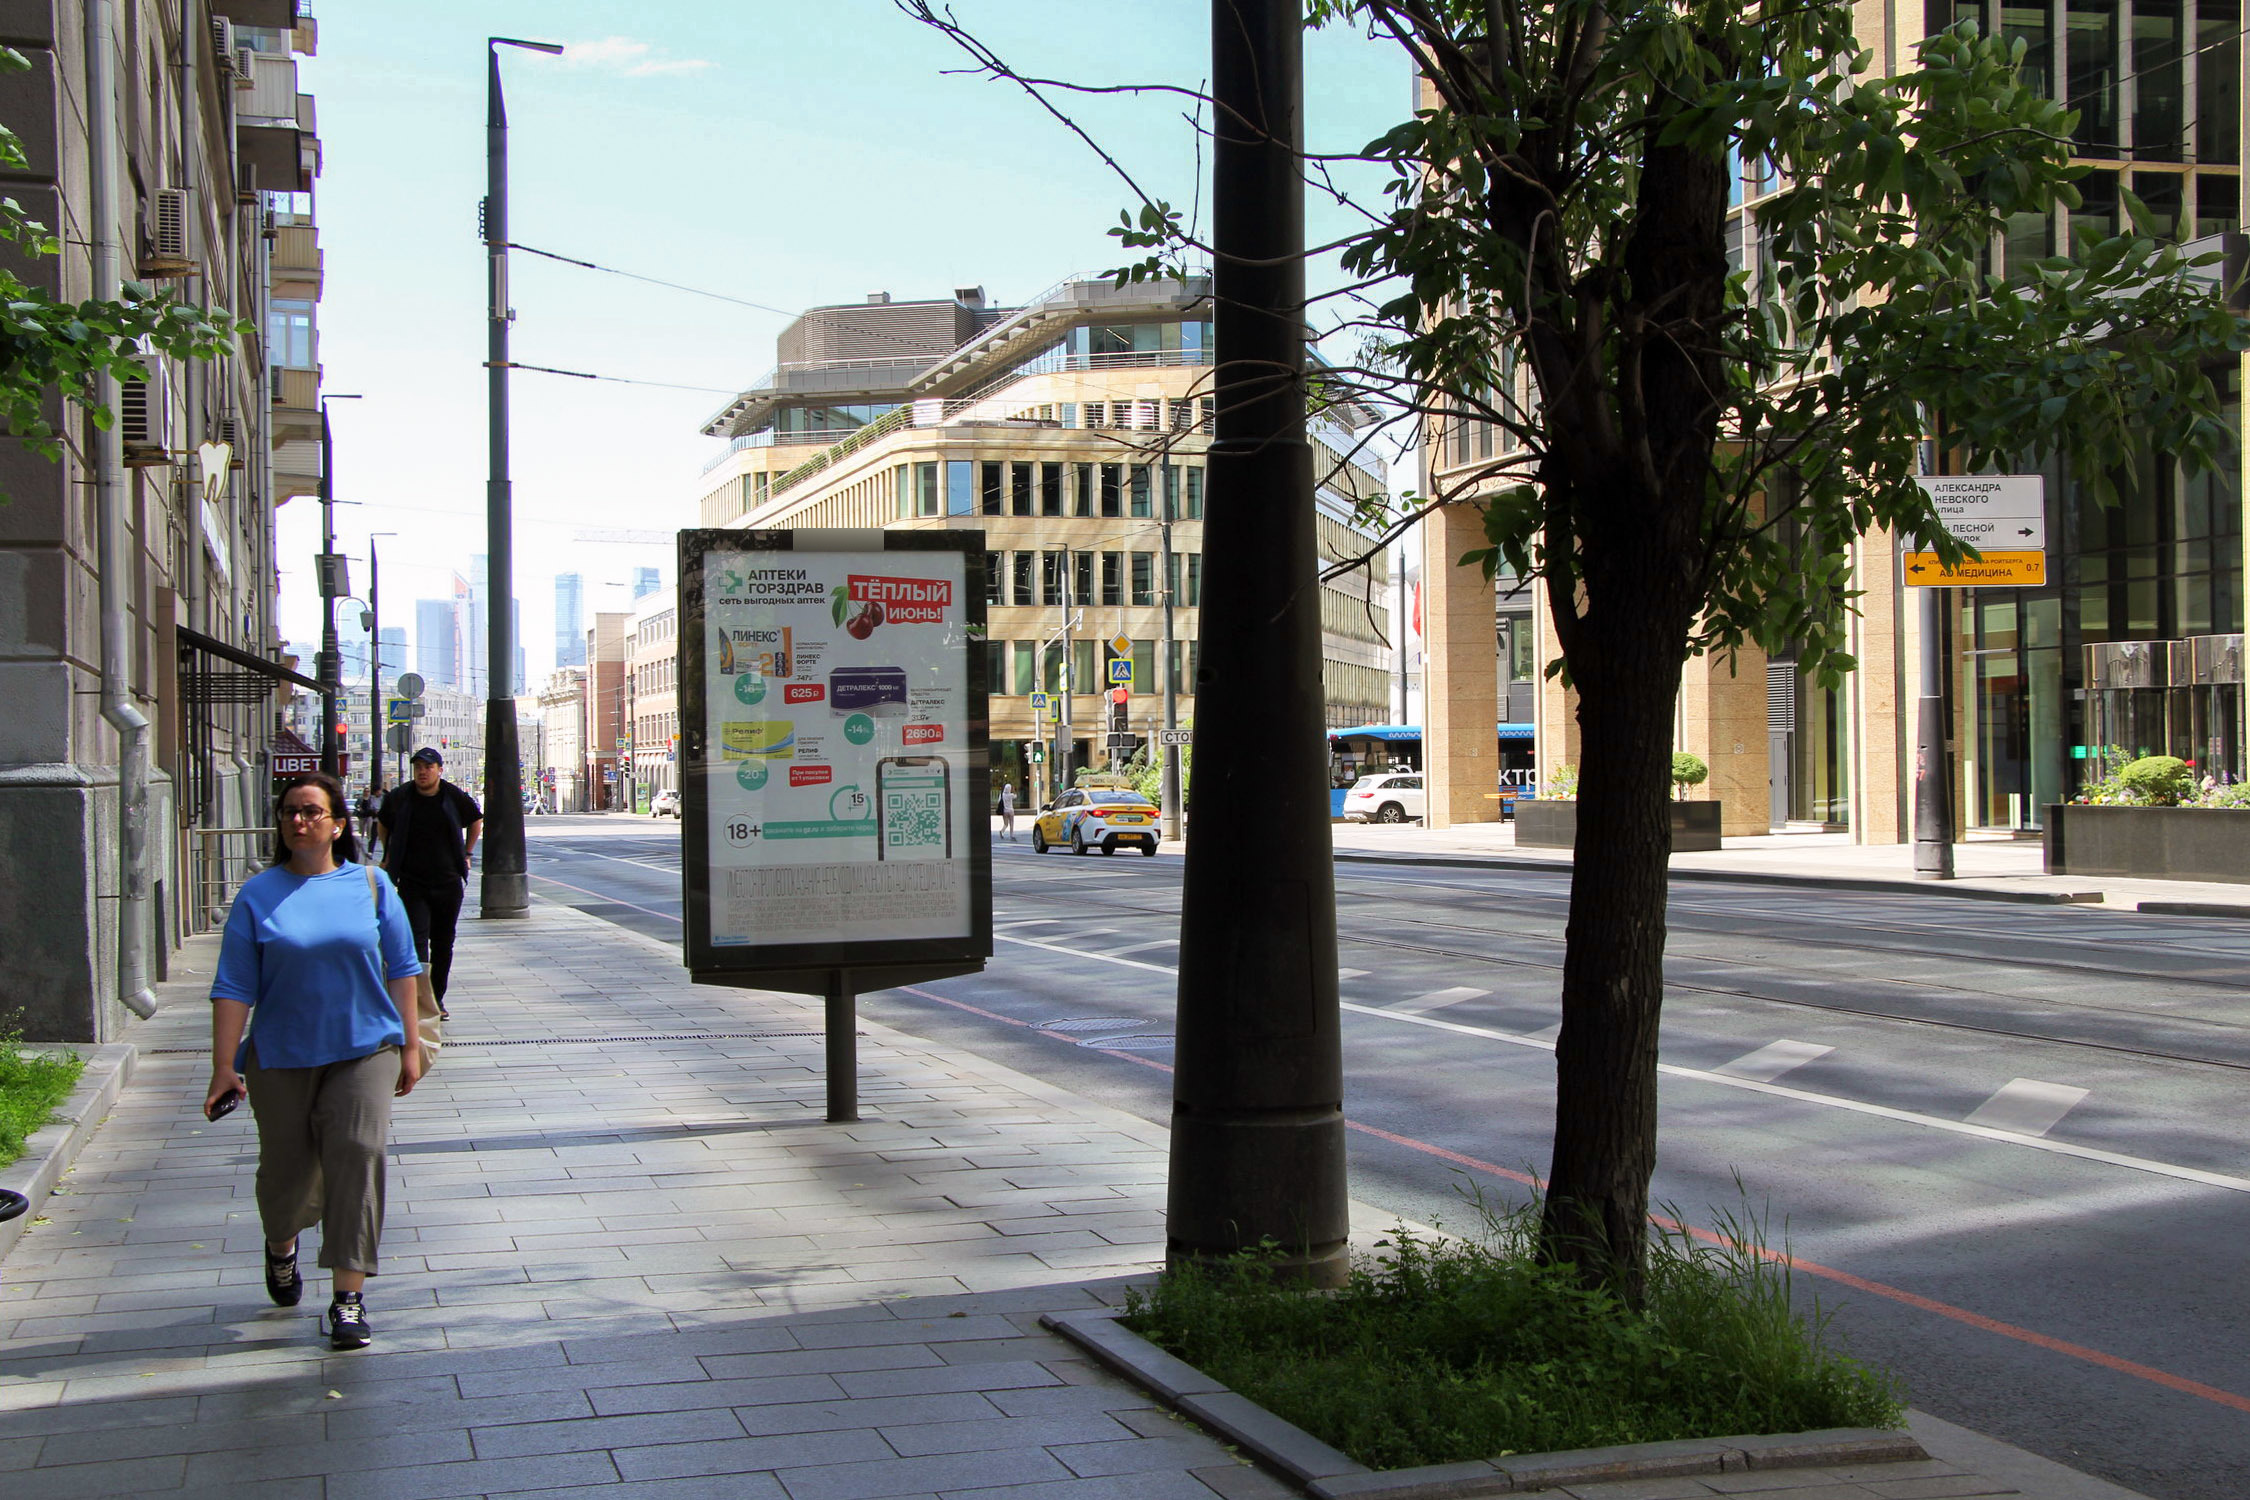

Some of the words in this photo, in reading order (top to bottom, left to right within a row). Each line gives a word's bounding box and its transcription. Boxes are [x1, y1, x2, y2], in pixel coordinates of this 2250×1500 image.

[1935, 483, 2001, 492] АЛЕКСАНДРА
[1935, 495, 1988, 504] НЕВСКОГО
[1935, 506, 1964, 514] улица
[1952, 522, 1995, 533] ЛЕСНОЙ
[1956, 568, 2013, 578] МЕДИЦИНА
[2026, 563, 2040, 572] 0.7
[748, 569, 806, 580] АПТЕКИ
[749, 583, 824, 595] ГОРЗДРАВ
[853, 579, 948, 603] ТЁПЛЫЙ
[719, 597, 742, 605] сеть
[744, 597, 794, 605] выгодных
[797, 596, 825, 604] аптек
[889, 607, 941, 620] ИЮНЬ!
[851, 793, 864, 804] 15
[727, 823, 761, 840] 18+
